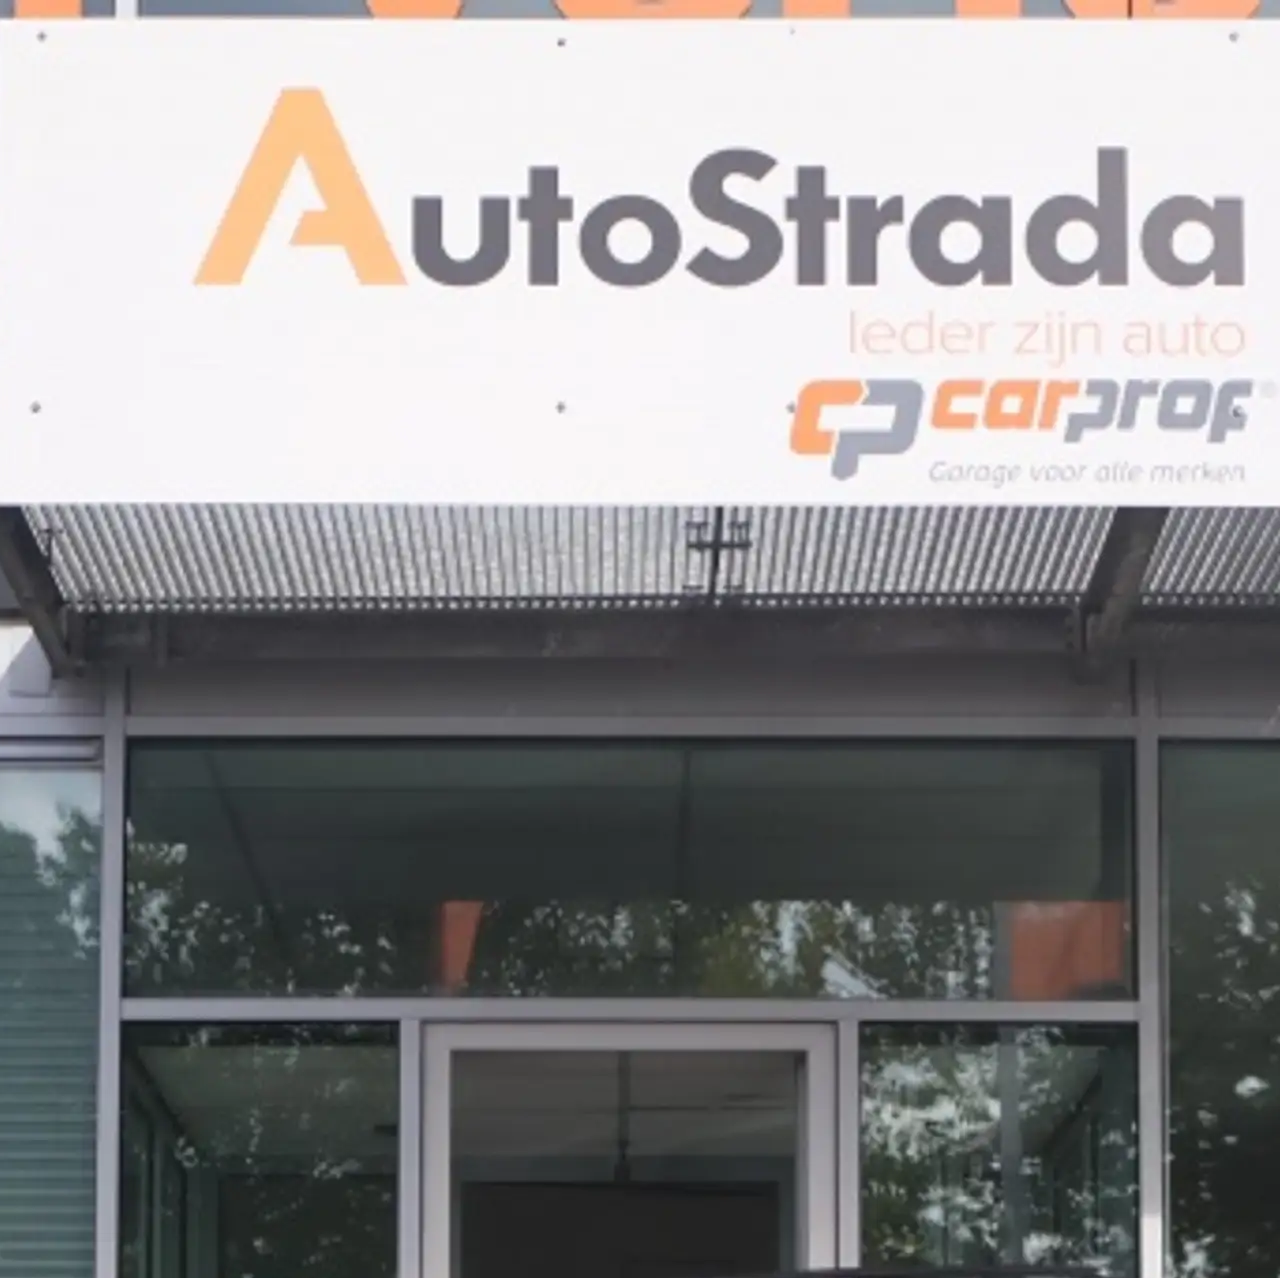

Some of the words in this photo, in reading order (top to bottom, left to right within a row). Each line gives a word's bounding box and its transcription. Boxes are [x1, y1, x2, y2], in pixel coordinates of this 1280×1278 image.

[195, 88, 1245, 289] AutoStrada
[848, 311, 995, 356] Ieder
[1014, 312, 1102, 370] zijn
[1122, 316, 1247, 358] auto
[930, 378, 1253, 443] carprof
[927, 460, 1021, 489] Garage
[1030, 464, 1087, 482] voor
[1094, 461, 1143, 482] alle
[1150, 461, 1246, 483] merken
